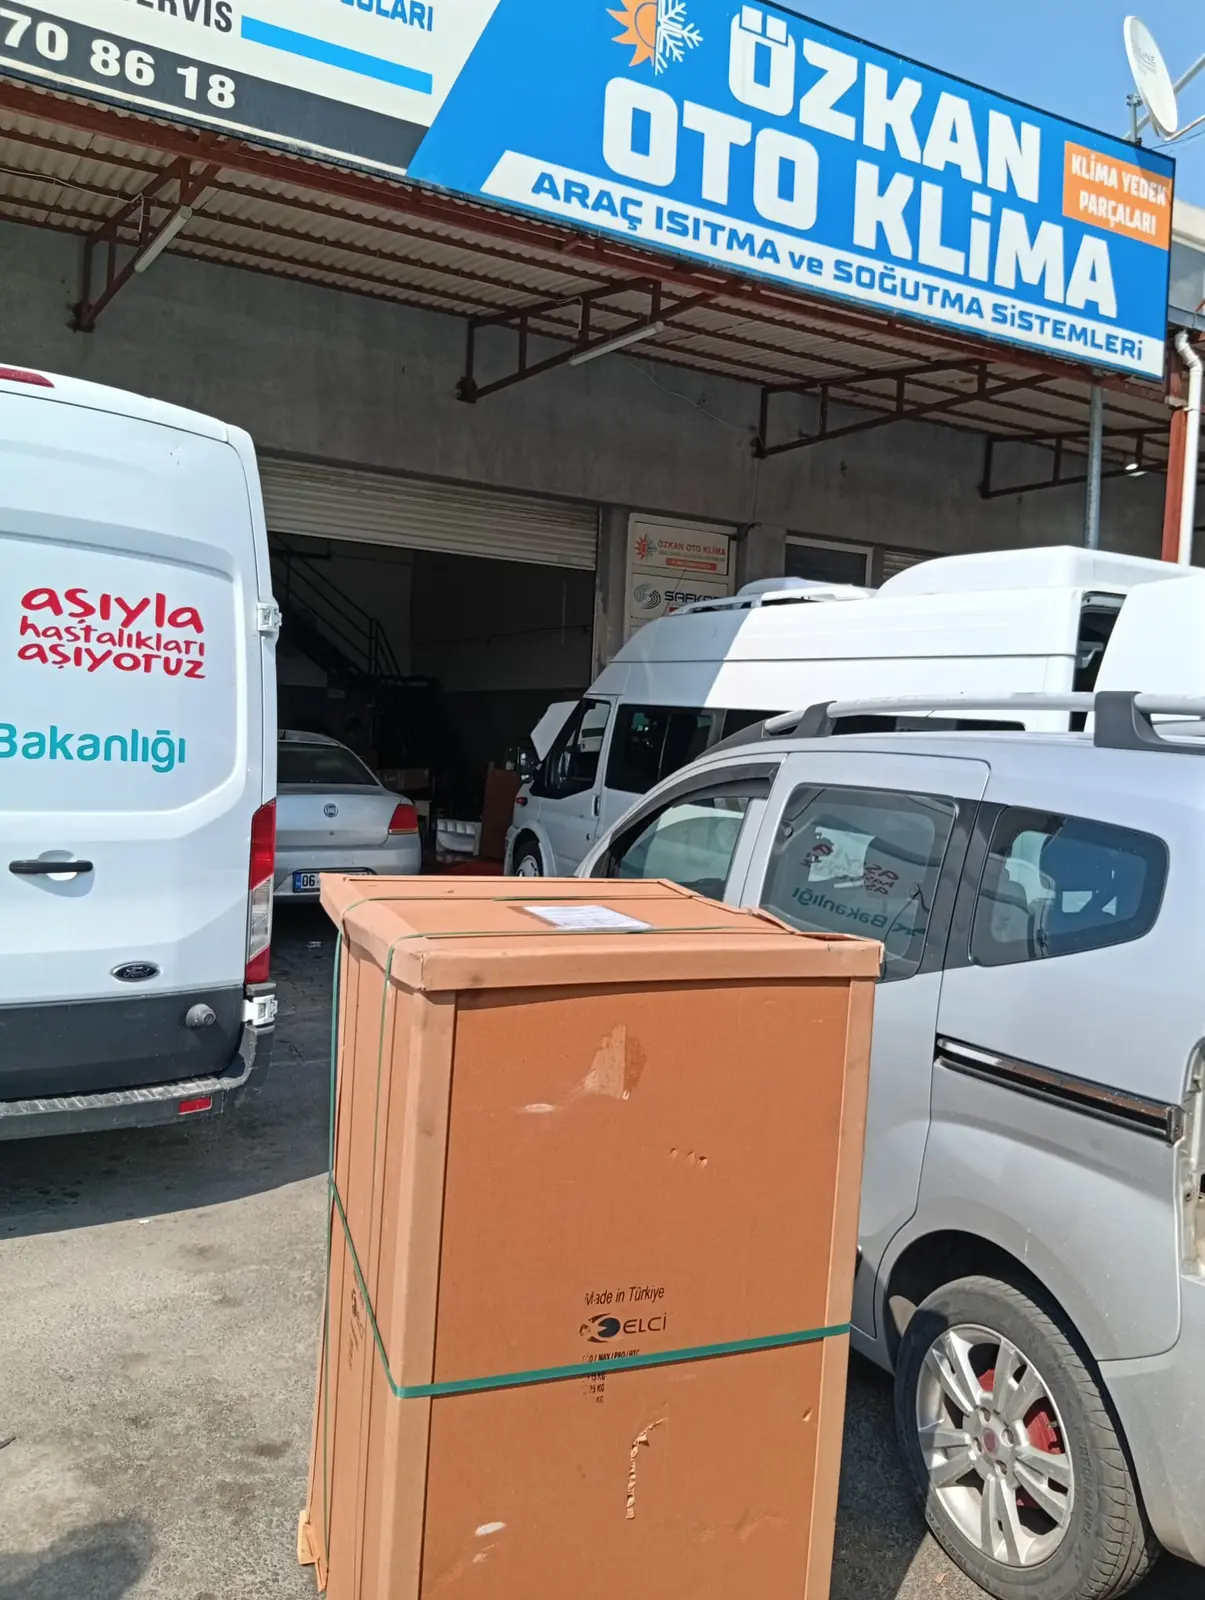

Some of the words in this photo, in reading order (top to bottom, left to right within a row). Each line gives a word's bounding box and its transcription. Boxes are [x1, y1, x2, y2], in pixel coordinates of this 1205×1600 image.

[90, 39, 155, 86] 86
[177, 66, 236, 109] 18
[729, 5, 1041, 203] ÖZKAN
[602, 76, 819, 231] OTO
[1071, 152, 1118, 190] KLİMA
[1121, 171, 1168, 207] YEDEK
[1079, 189, 1157, 236] PARÇALARI
[531, 172, 642, 231] ARAÇ
[655, 206, 780, 264] ISITMA
[788, 251, 823, 276] ve
[833, 259, 984, 319] SOĞUTMA
[21, 587, 204, 634] aşıyla
[20, 615, 205, 656] hastalıkları
[17, 643, 206, 679] aşıyoruz
[0, 723, 186, 773] Bakanlığı
[302, 874, 316, 887] 06
[585, 1291, 613, 1306] Made
[615, 1288, 625, 1302] in
[629, 1284, 665, 1303] Türkiye
